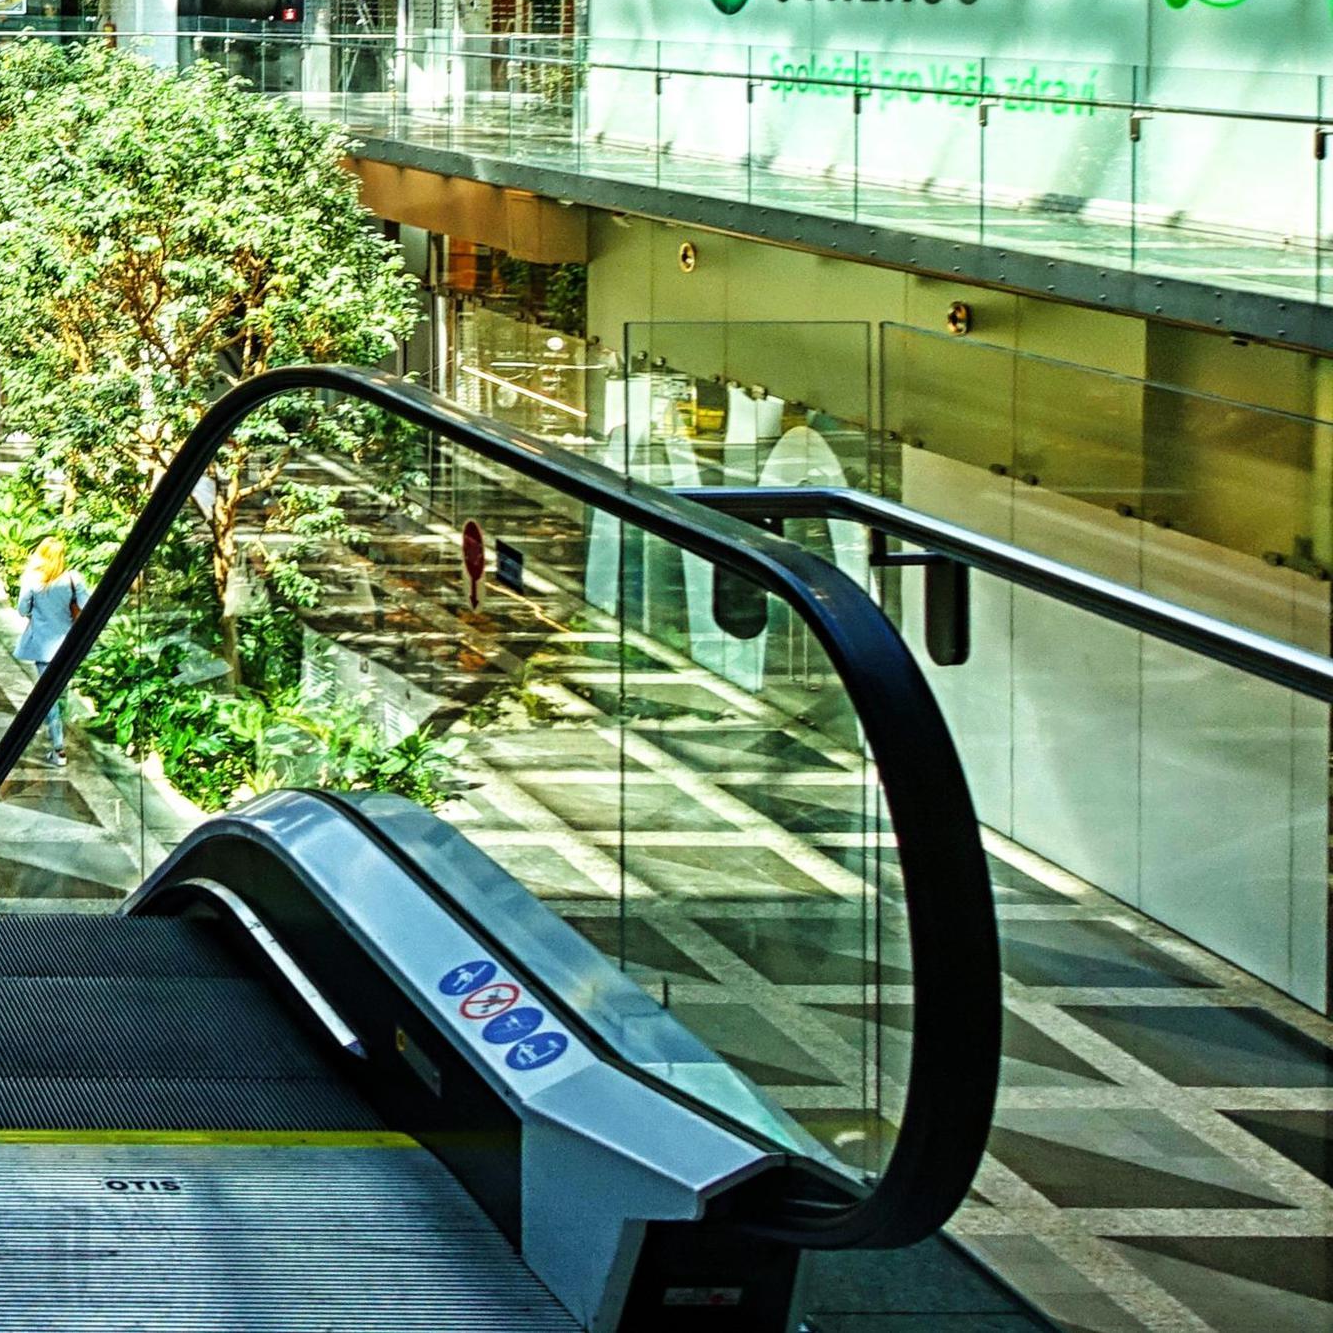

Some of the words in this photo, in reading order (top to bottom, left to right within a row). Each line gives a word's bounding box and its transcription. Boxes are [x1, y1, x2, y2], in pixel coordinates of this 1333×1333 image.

[879, 68, 923, 112] pro
[1003, 65, 1099, 117] zdraví
[105, 1180, 182, 1192] OTIS
